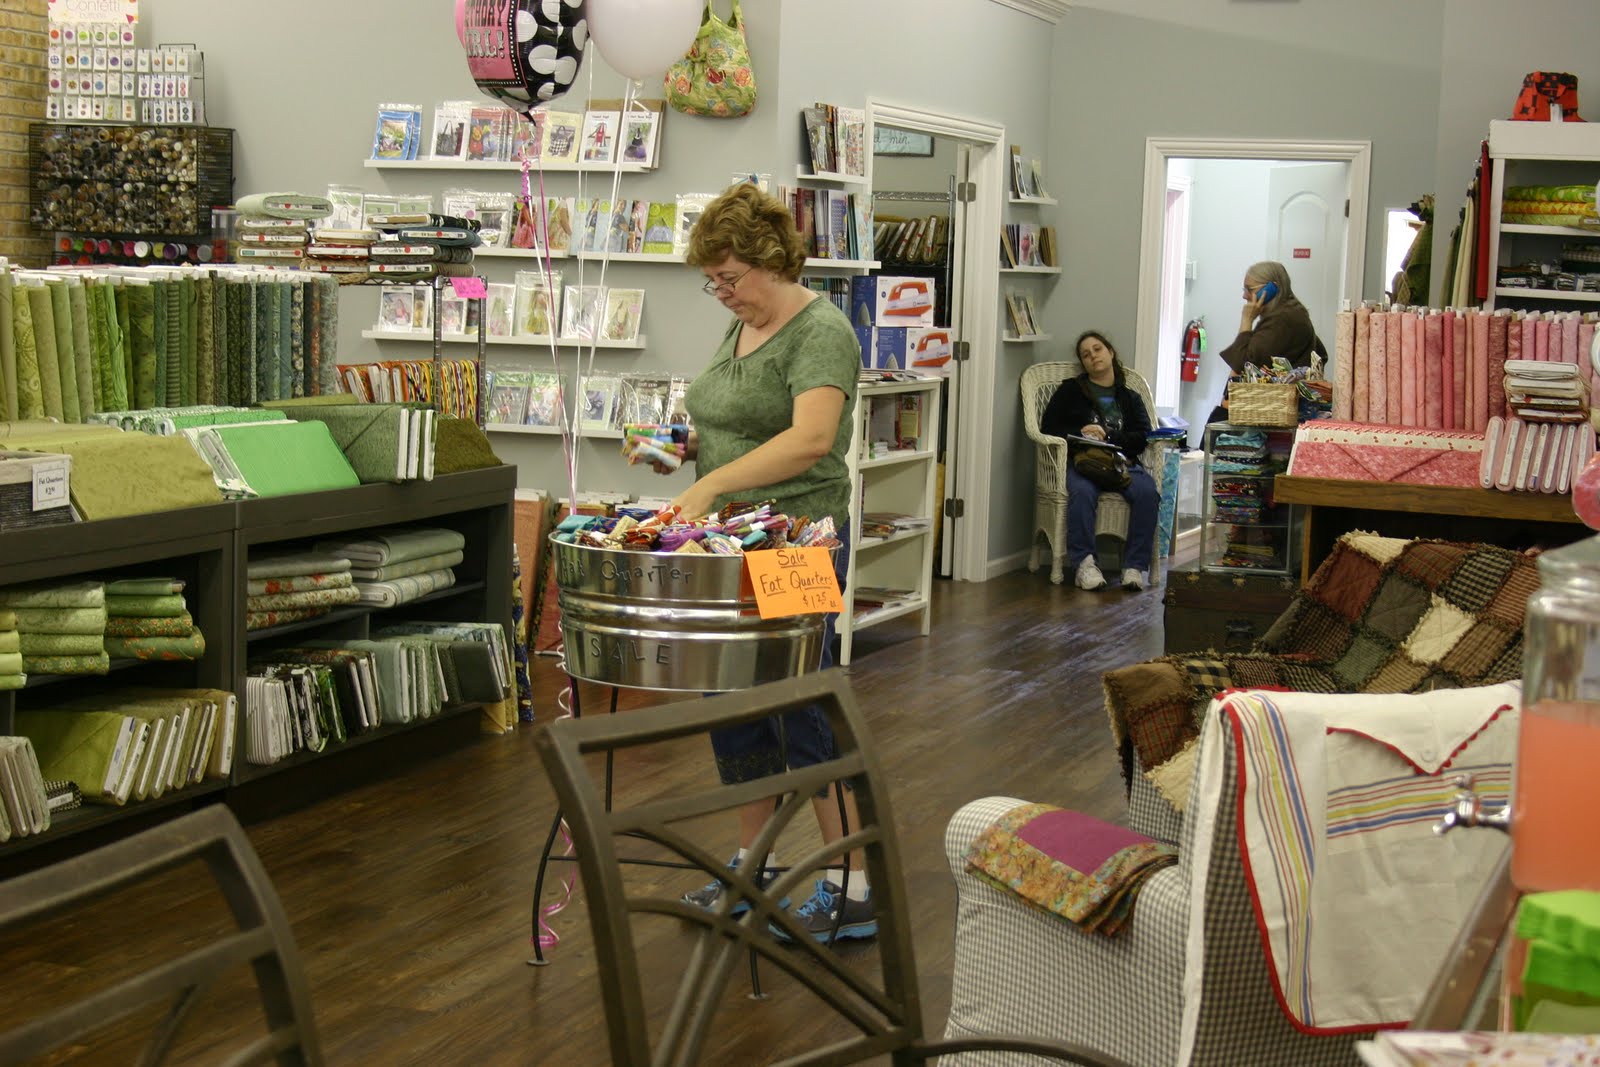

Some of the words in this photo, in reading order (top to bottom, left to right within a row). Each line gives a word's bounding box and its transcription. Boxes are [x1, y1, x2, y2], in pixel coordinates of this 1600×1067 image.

[776, 550, 805, 566] Sale
[760, 573, 783, 594] Fat
[789, 570, 833, 593] Quarters
[590, 637, 672, 666] SALE
